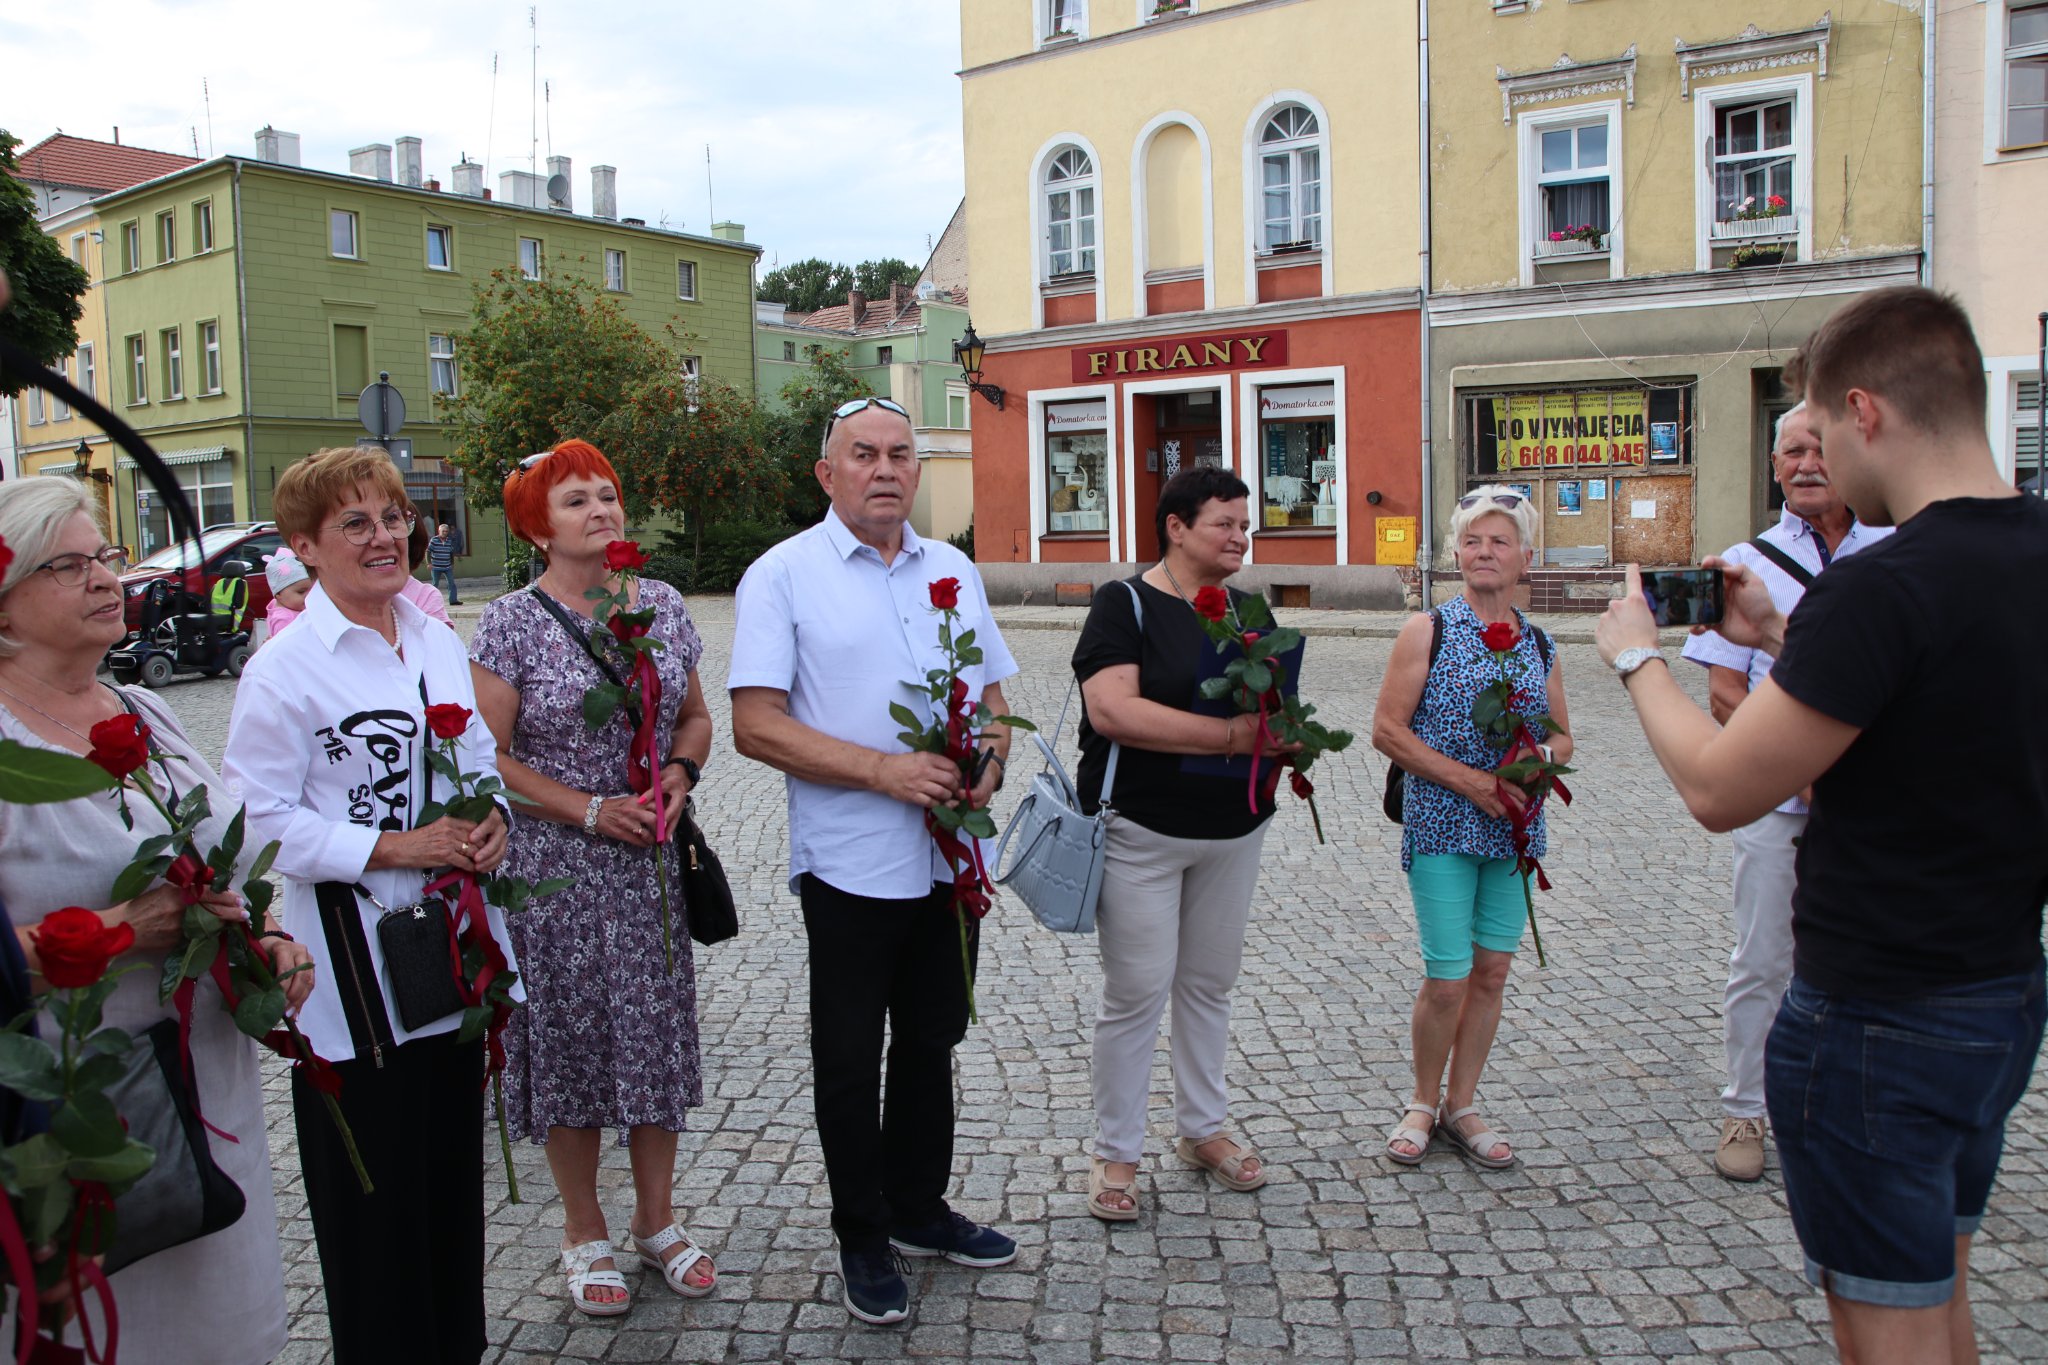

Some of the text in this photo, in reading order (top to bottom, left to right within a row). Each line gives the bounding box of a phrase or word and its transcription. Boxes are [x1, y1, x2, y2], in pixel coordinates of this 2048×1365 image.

[1088, 336, 1269, 376] FIRANY
[1272, 398, 1335, 410] Domatorka.com
[1498, 414, 1644, 441] DO WYNAJĘCIA
[1520, 443, 1644, 467] 668 044 945
[315, 727, 352, 766] ME
